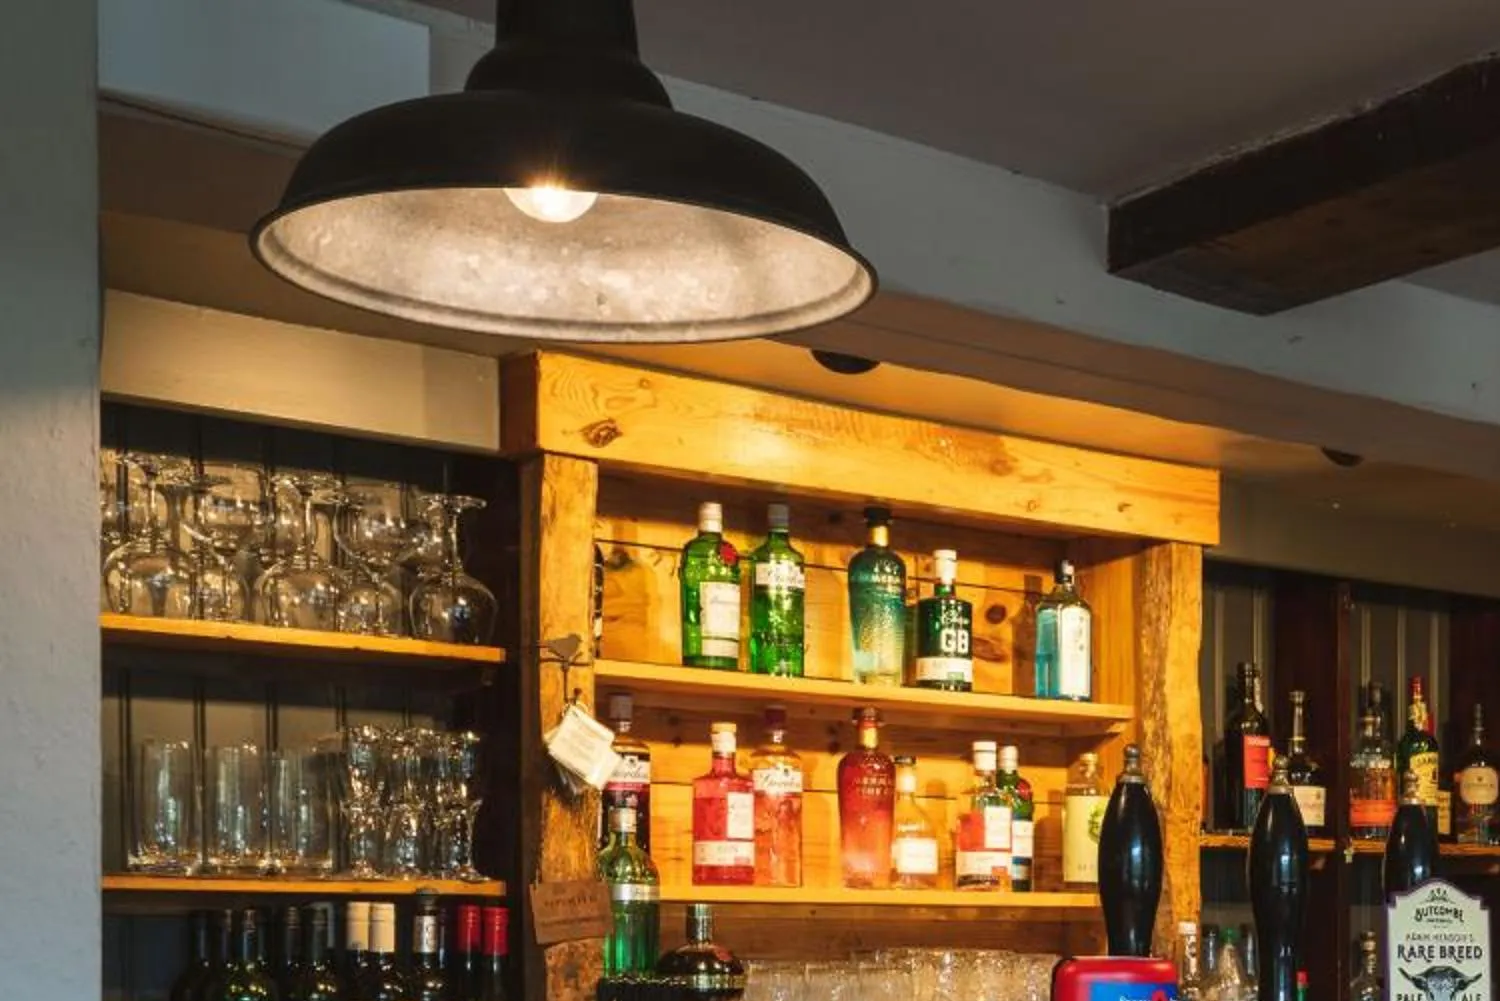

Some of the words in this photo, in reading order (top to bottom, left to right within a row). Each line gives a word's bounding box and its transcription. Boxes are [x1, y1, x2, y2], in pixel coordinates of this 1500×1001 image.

[941, 629, 969, 654] GB
[1414, 905, 1465, 922] BUTCOMBE
[1397, 944, 1436, 963] RARE
[1439, 945, 1483, 963] BREED
